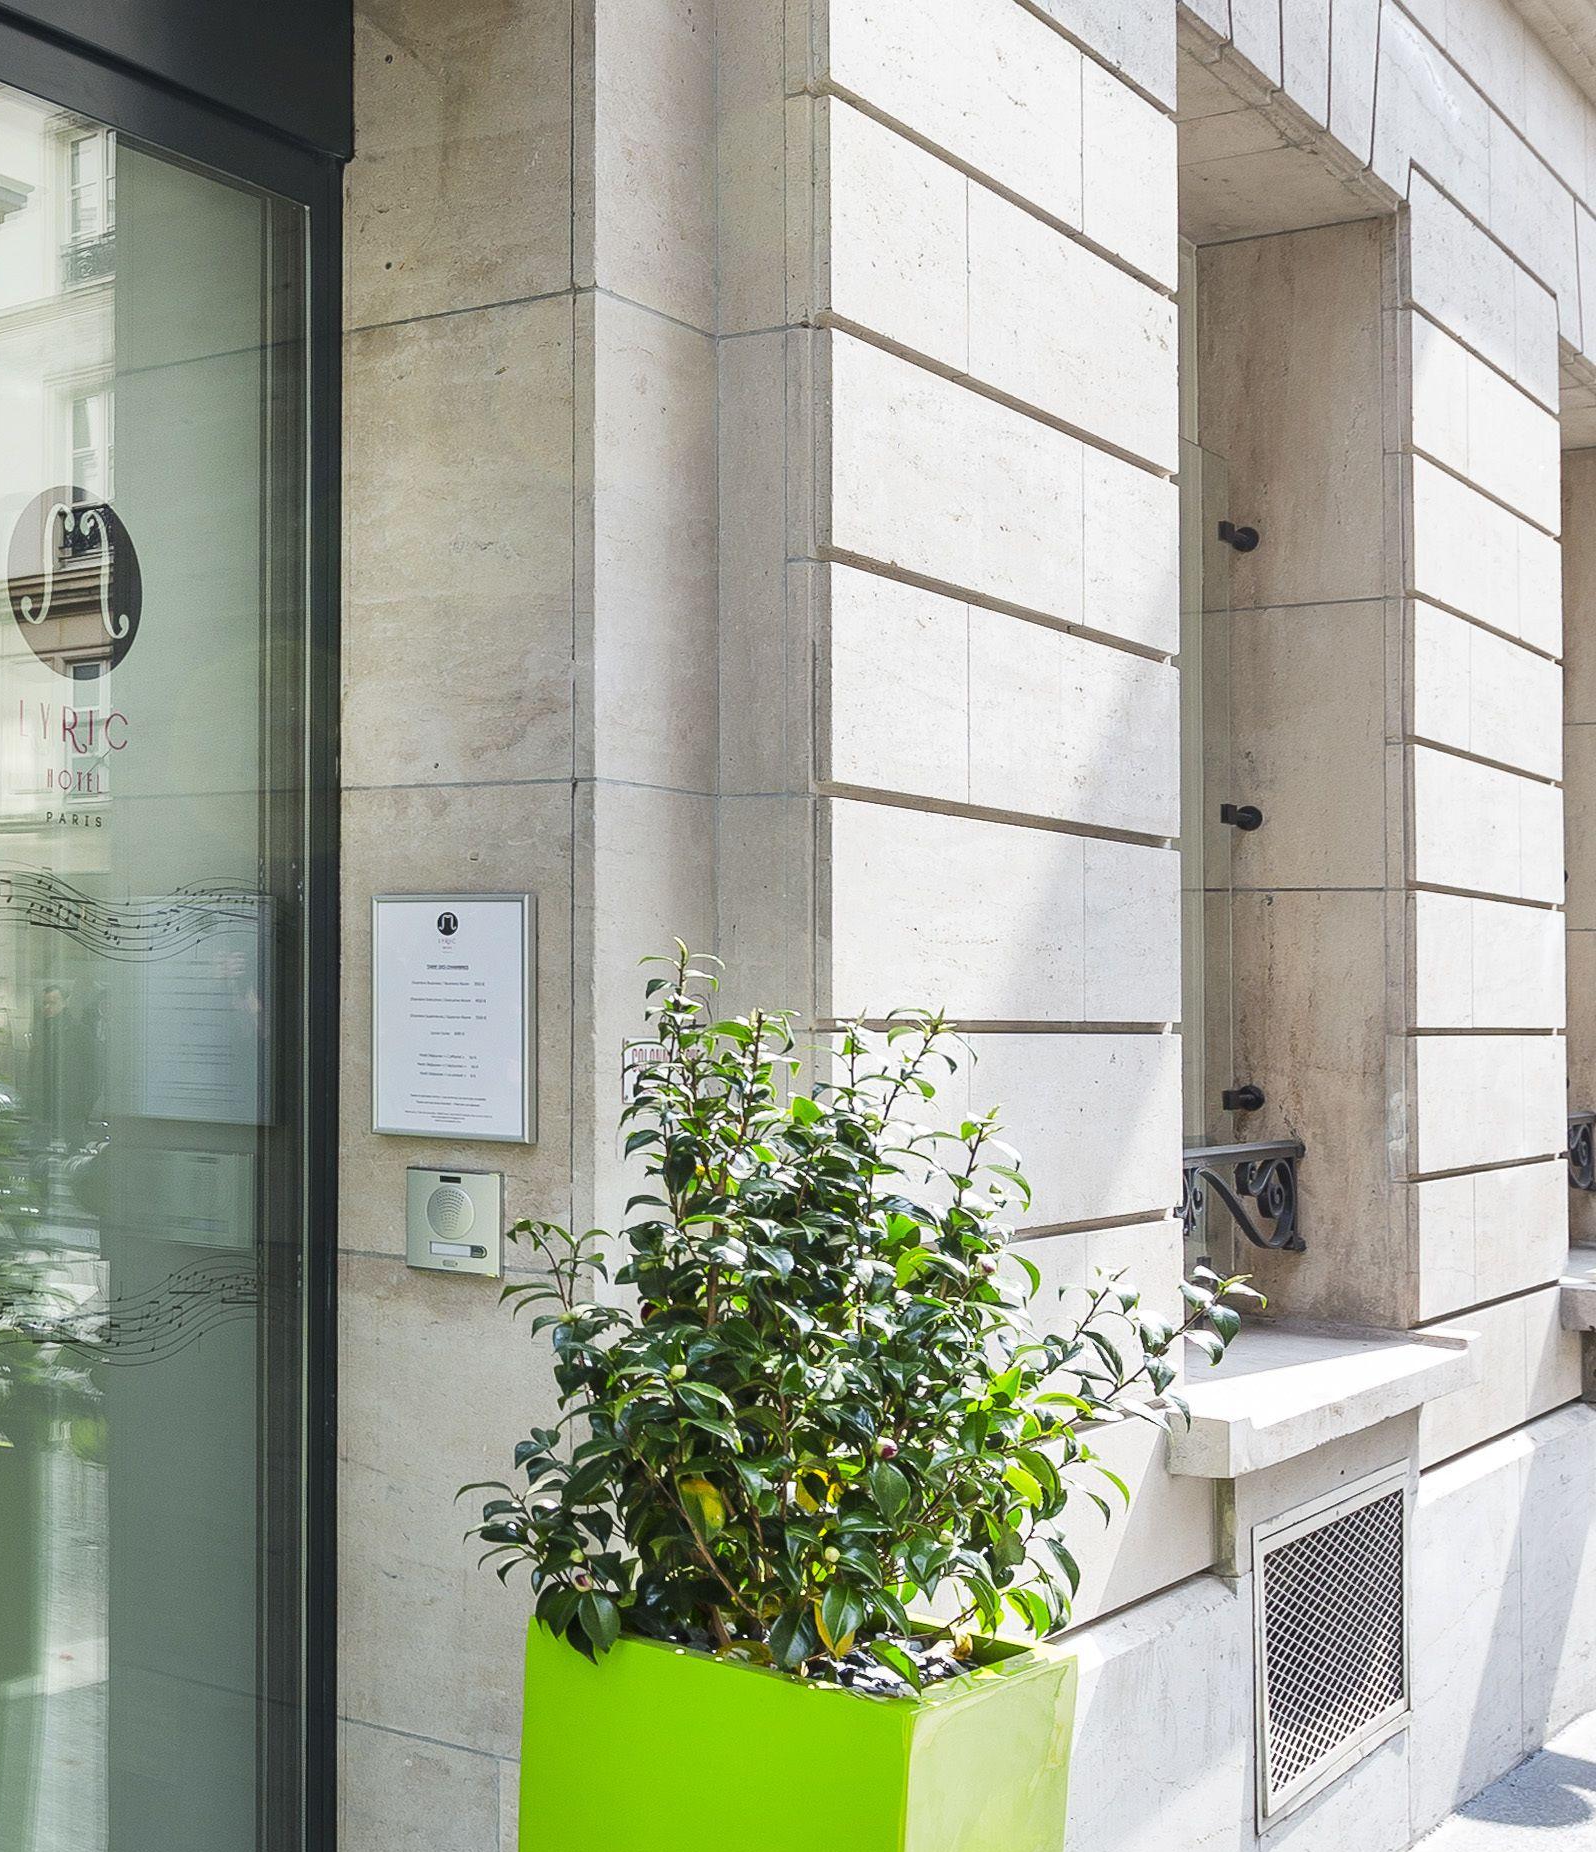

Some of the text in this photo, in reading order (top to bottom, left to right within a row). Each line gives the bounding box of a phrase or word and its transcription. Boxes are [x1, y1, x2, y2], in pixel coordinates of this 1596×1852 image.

[19, 699, 128, 754] LYRIC
[47, 768, 104, 794] HOTEL
[46, 811, 102, 828] PARIS
